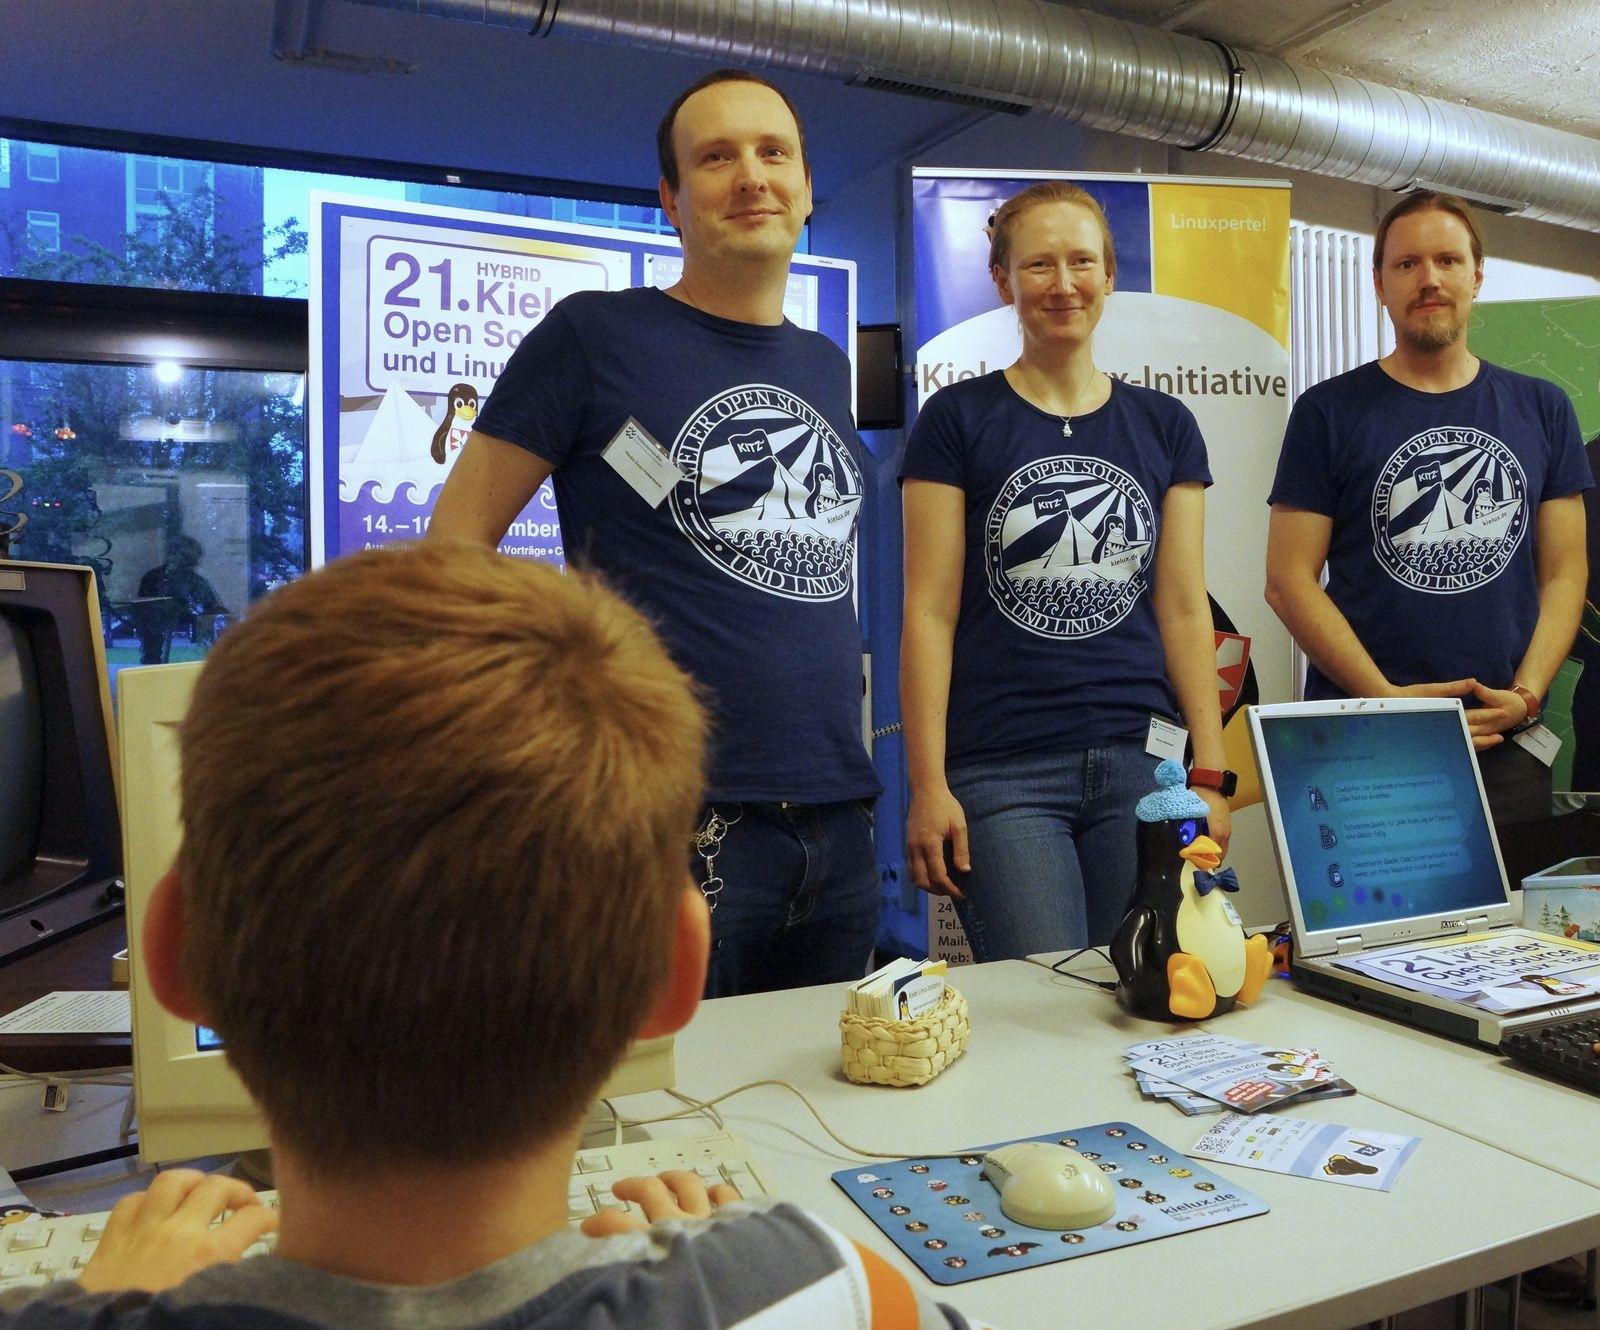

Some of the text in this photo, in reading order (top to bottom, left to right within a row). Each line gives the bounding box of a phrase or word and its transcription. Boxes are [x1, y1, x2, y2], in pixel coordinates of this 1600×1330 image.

[1170, 213, 1267, 232] Linuxperte!
[384, 252, 556, 319] 21. Kiel
[477, 262, 541, 282] HYBRID
[384, 311, 471, 347] Open
[383, 352, 436, 374] und
[1102, 365, 1287, 397] -Initiative
[714, 390, 770, 419] OPEN
[777, 393, 850, 461] SOURCE
[1376, 430, 1517, 516] KIELER OPEN SOURCE
[988, 460, 1147, 543] KIELER OPEN SOURCE
[504, 545, 547, 557] Vorträge
[1394, 532, 1518, 589] UND LINUX TAGE
[730, 553, 847, 594] UND LINUX
[1011, 576, 1147, 634] UND LINUX TAGE
[938, 936, 968, 946] Mail:
[1452, 942, 1549, 963] Kieler
[938, 952, 970, 963] Web:
[1421, 948, 1578, 980] Open Source
[1450, 972, 1496, 987] und
[1491, 961, 1551, 977] Linux
[1160, 1193, 1237, 1214] kielux.de
